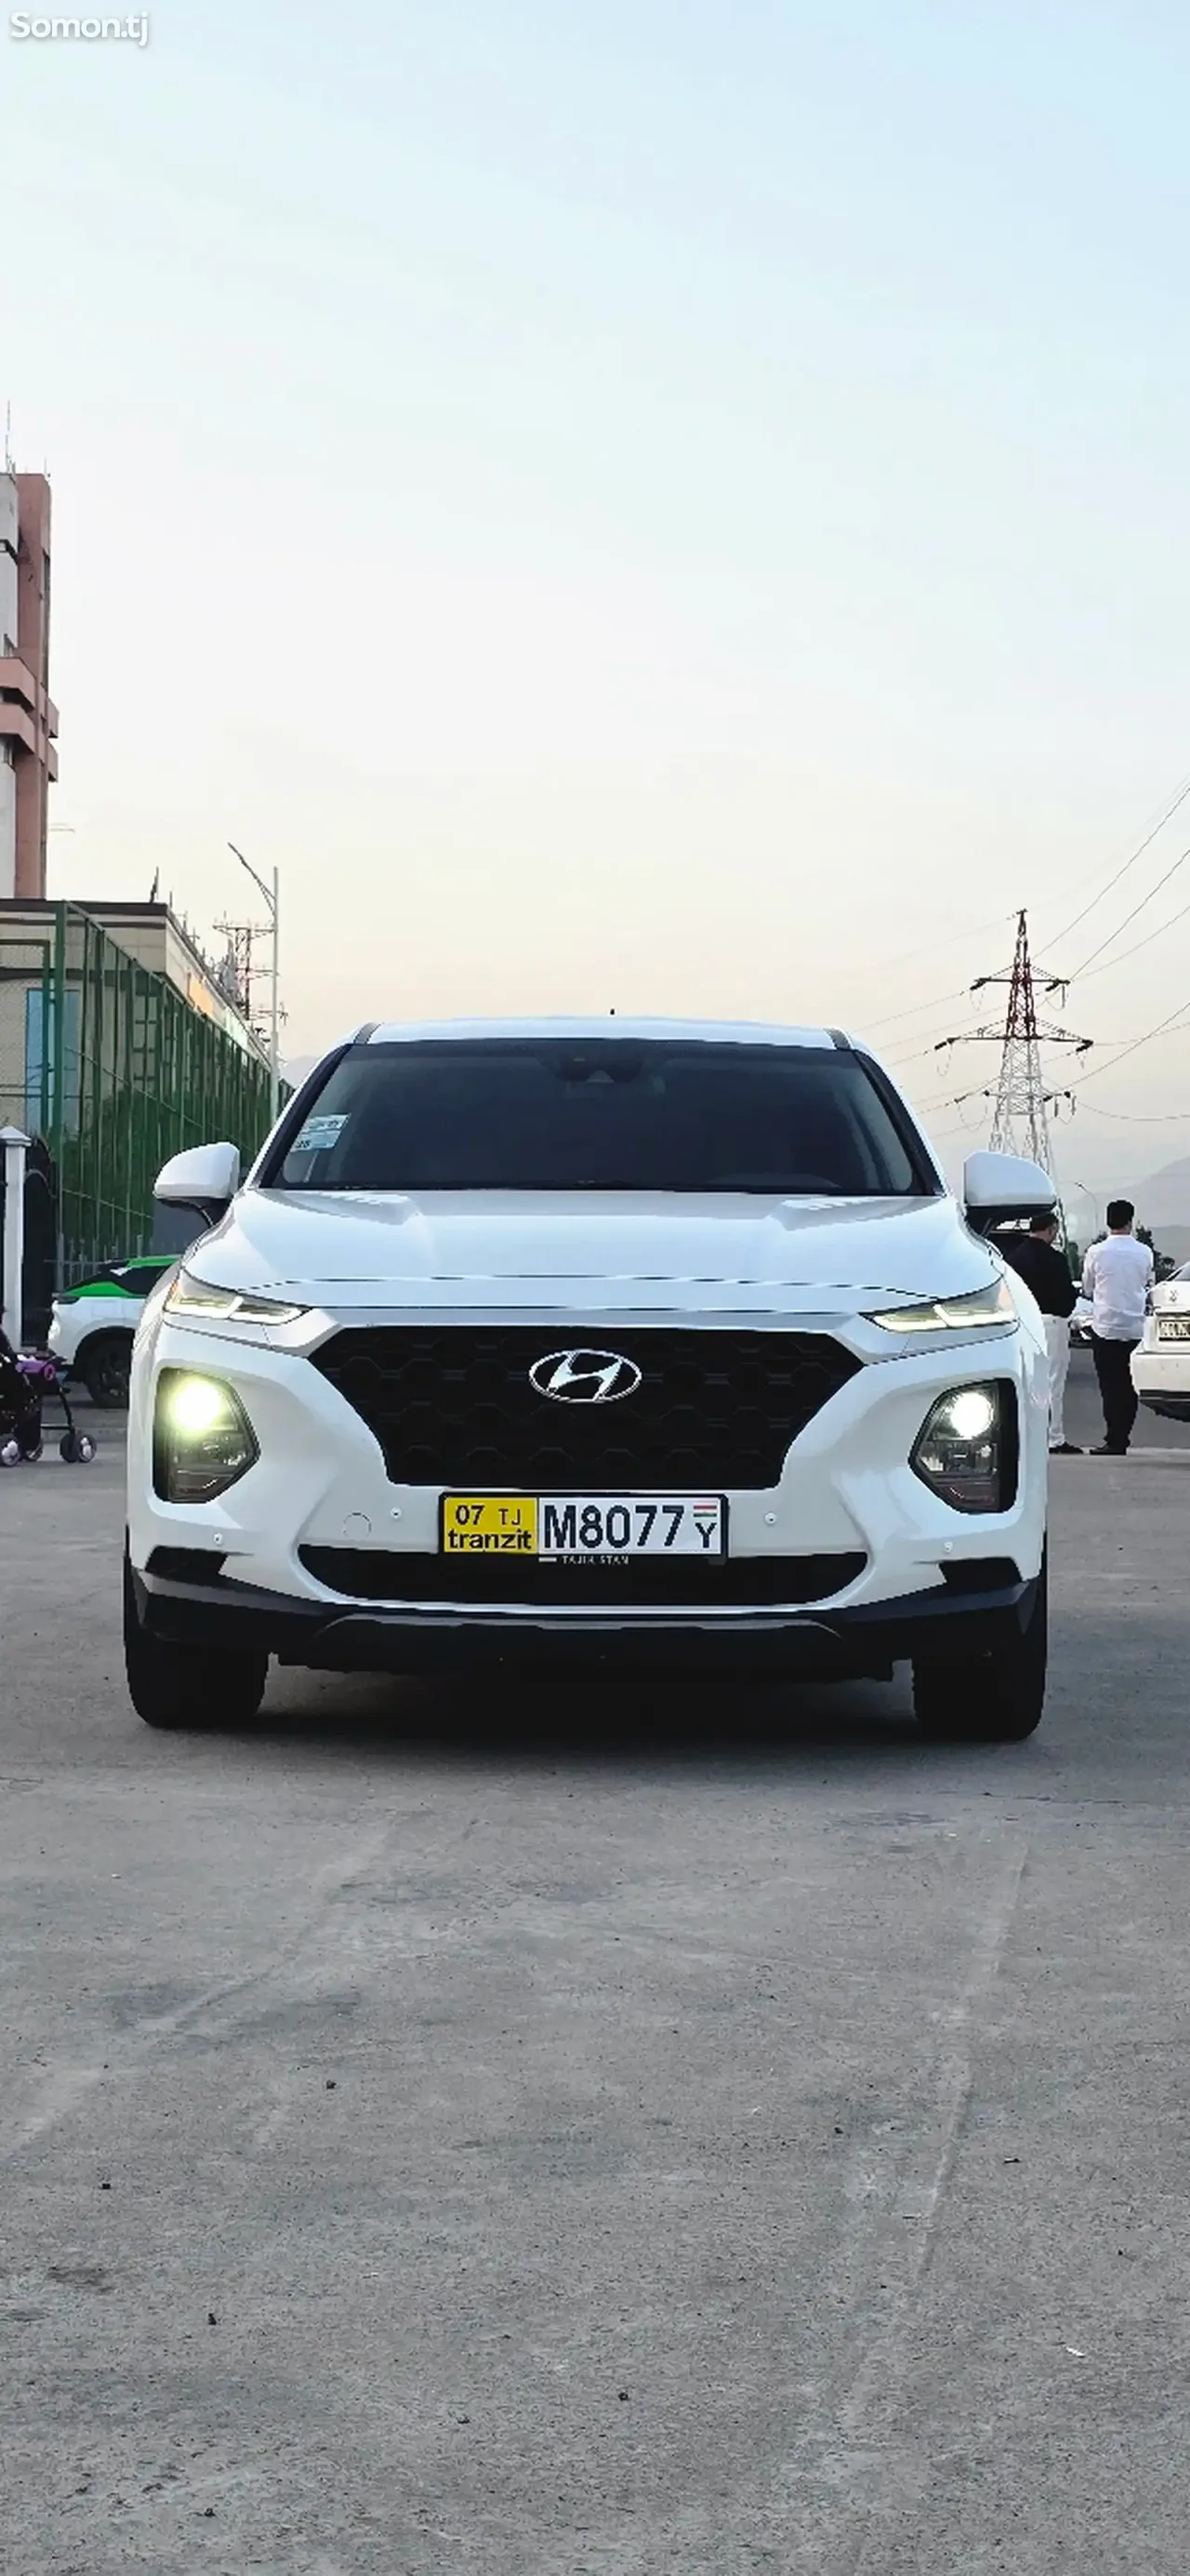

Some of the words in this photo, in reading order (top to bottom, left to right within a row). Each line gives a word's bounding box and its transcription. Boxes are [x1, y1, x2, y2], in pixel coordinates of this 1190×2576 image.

[455, 1504, 485, 1526] 07
[498, 1507, 522, 1526] TJ
[544, 1505, 684, 1548] M8077
[448, 1528, 533, 1549] tranzit
[694, 1522, 717, 1548] Y
